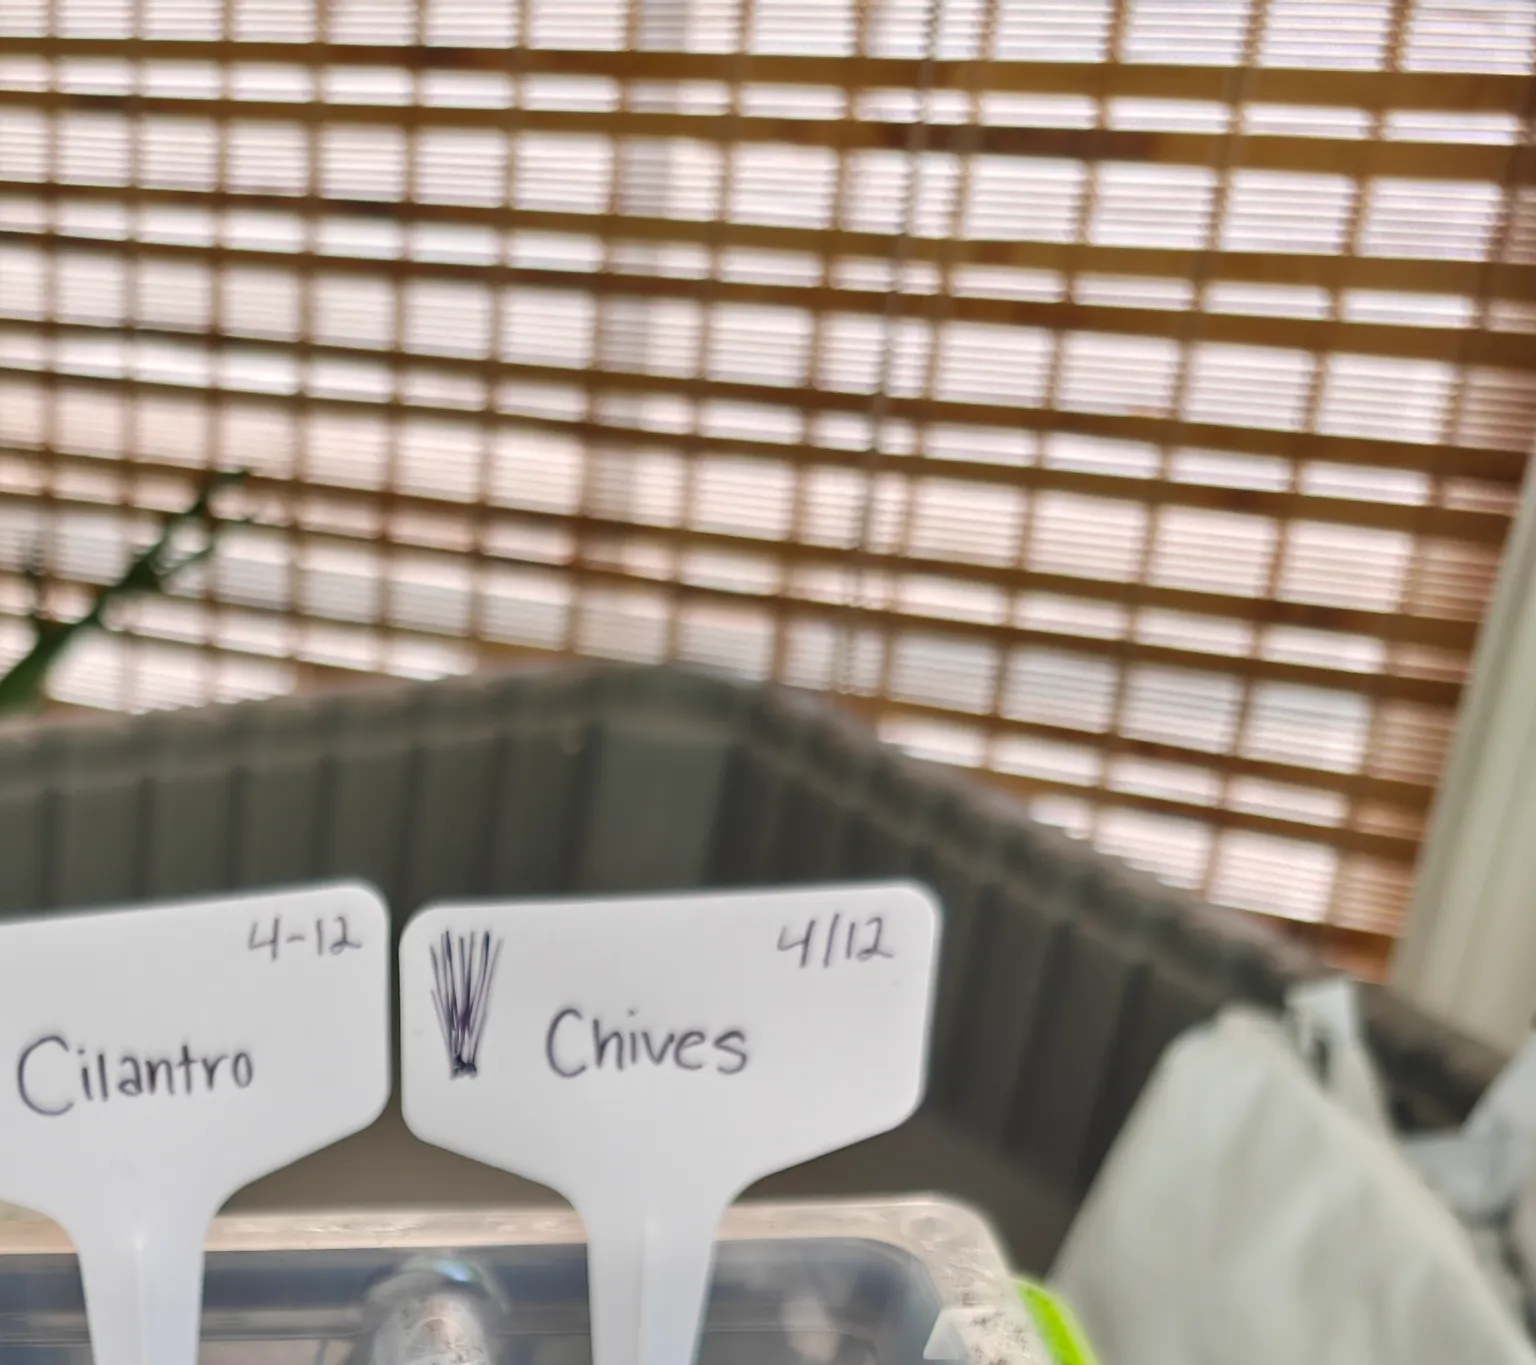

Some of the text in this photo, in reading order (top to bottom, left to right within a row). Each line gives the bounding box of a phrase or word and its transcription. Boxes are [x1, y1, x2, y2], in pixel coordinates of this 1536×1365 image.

[247, 914, 363, 962] 4-12
[776, 912, 894, 969] 4/12
[16, 1033, 256, 1117] Cilantro
[544, 1006, 750, 1079] Chives
